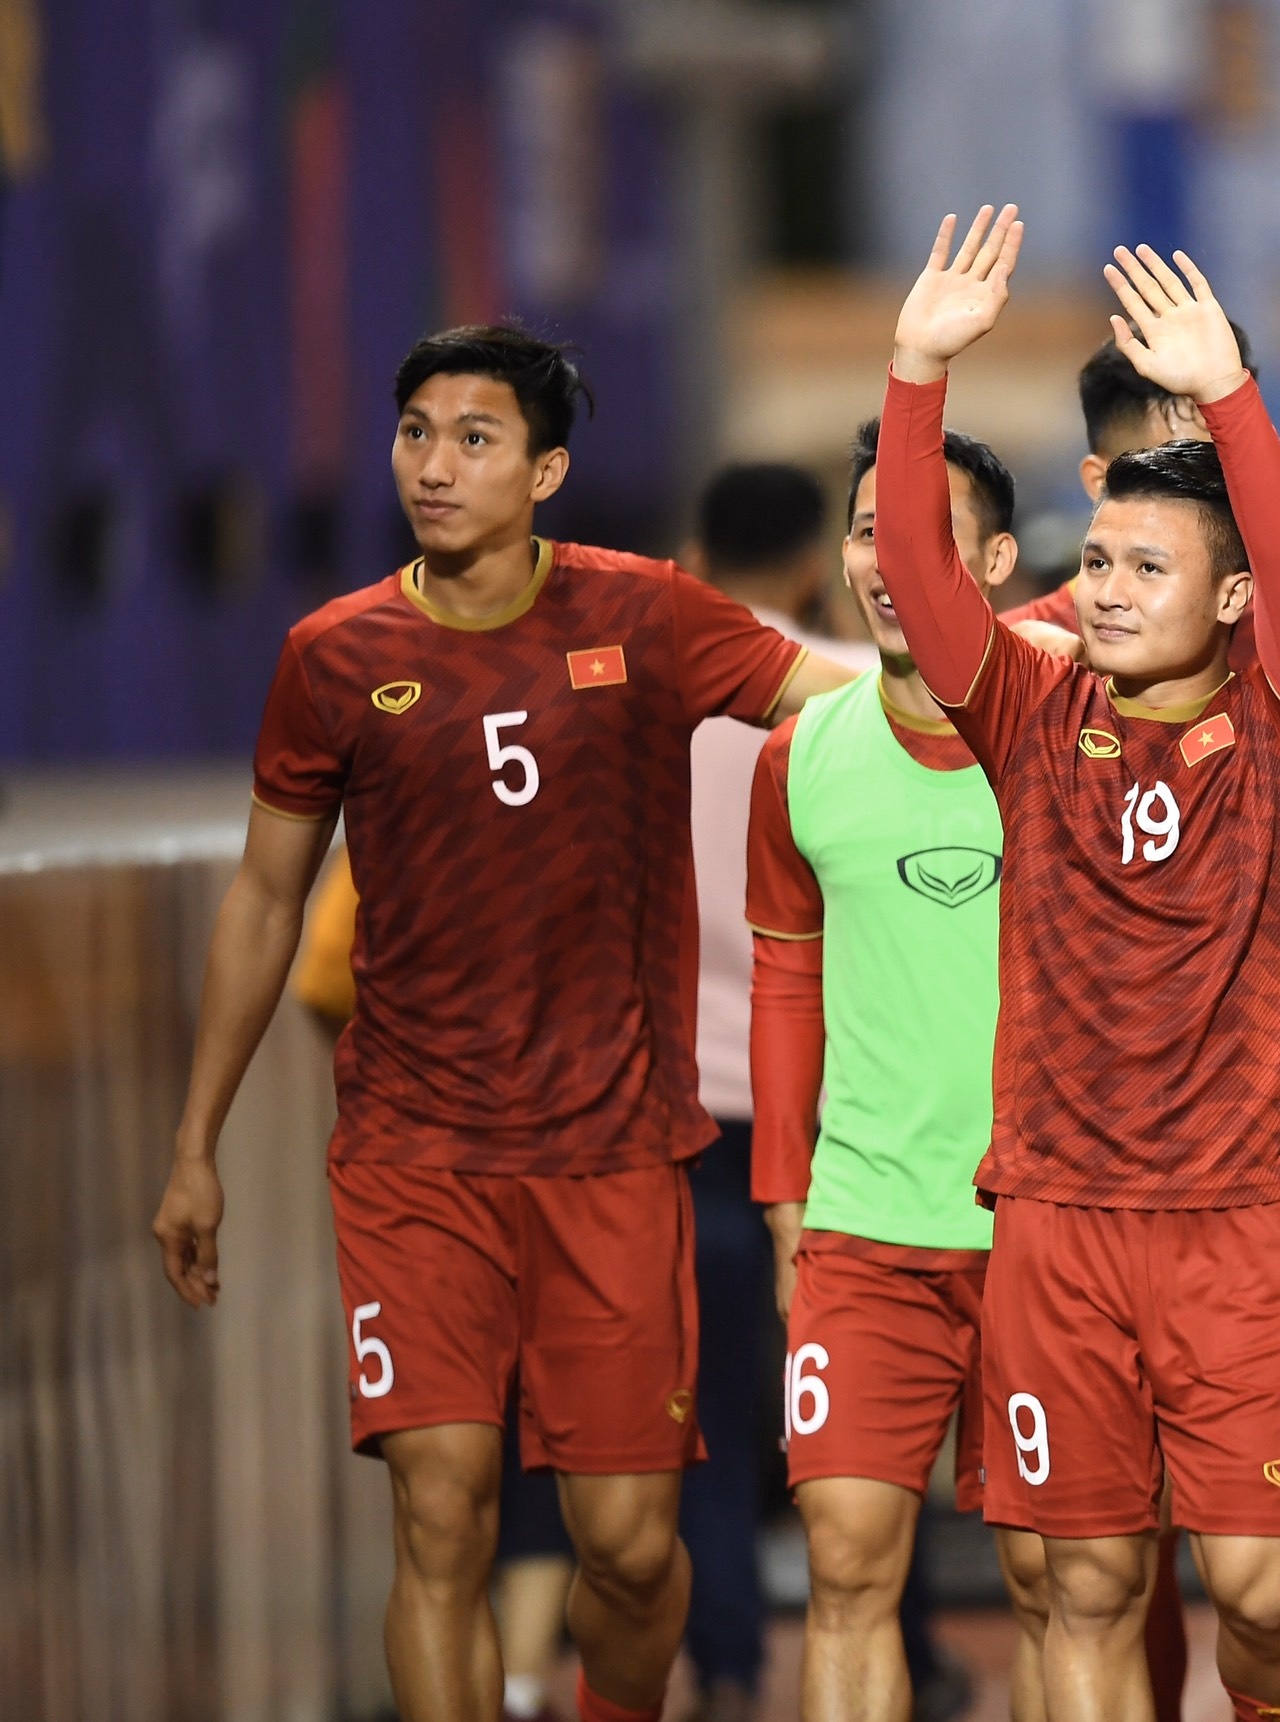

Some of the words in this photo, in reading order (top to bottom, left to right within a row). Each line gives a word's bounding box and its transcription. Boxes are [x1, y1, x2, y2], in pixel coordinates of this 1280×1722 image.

[482, 710, 540, 806] 5
[1121, 780, 1181, 865] 19
[352, 1301, 394, 1398] 5
